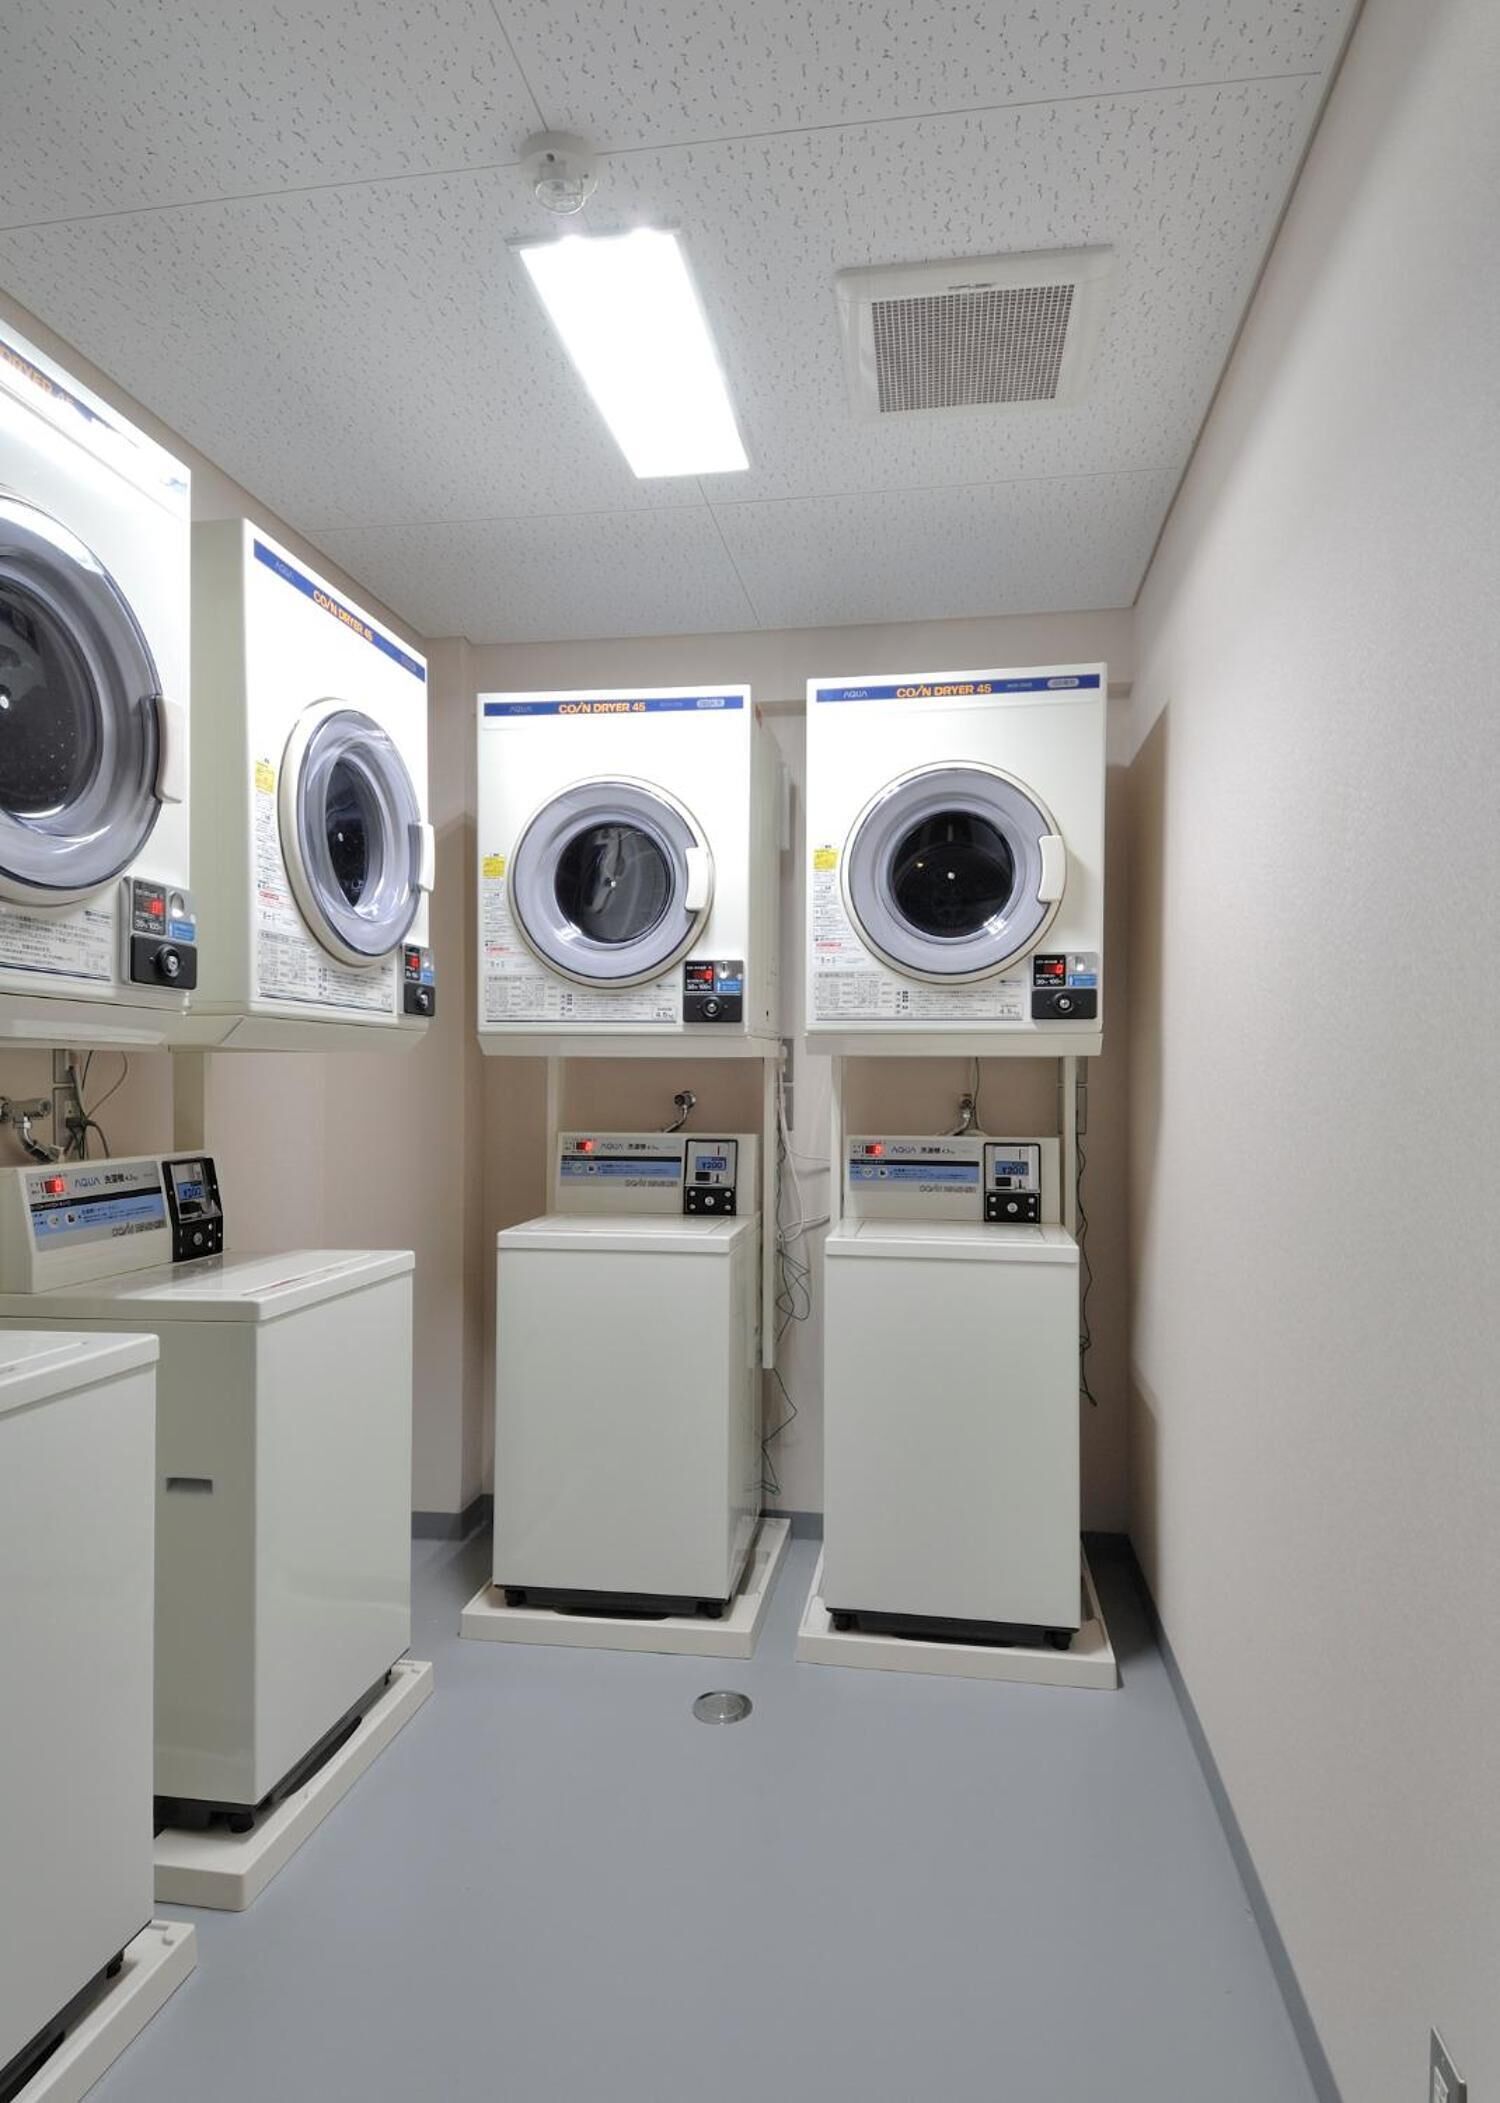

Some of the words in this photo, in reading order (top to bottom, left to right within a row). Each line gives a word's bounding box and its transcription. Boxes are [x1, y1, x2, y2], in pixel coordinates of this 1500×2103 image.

[313, 590, 338, 617] COIN
[338, 609, 364, 637] DRYER
[364, 628, 374, 643] 45
[843, 690, 868, 699] AQUA
[896, 685, 931, 699] COIN
[934, 685, 974, 696] DRYER
[976, 684, 992, 694] 45
[508, 705, 533, 713] AQUA
[558, 701, 591, 714] COIN
[593, 703, 629, 713] DRYER
[632, 702, 646, 712] 45
[891, 1145, 916, 1153] AQUA
[74, 1178, 101, 1188] AQUA
